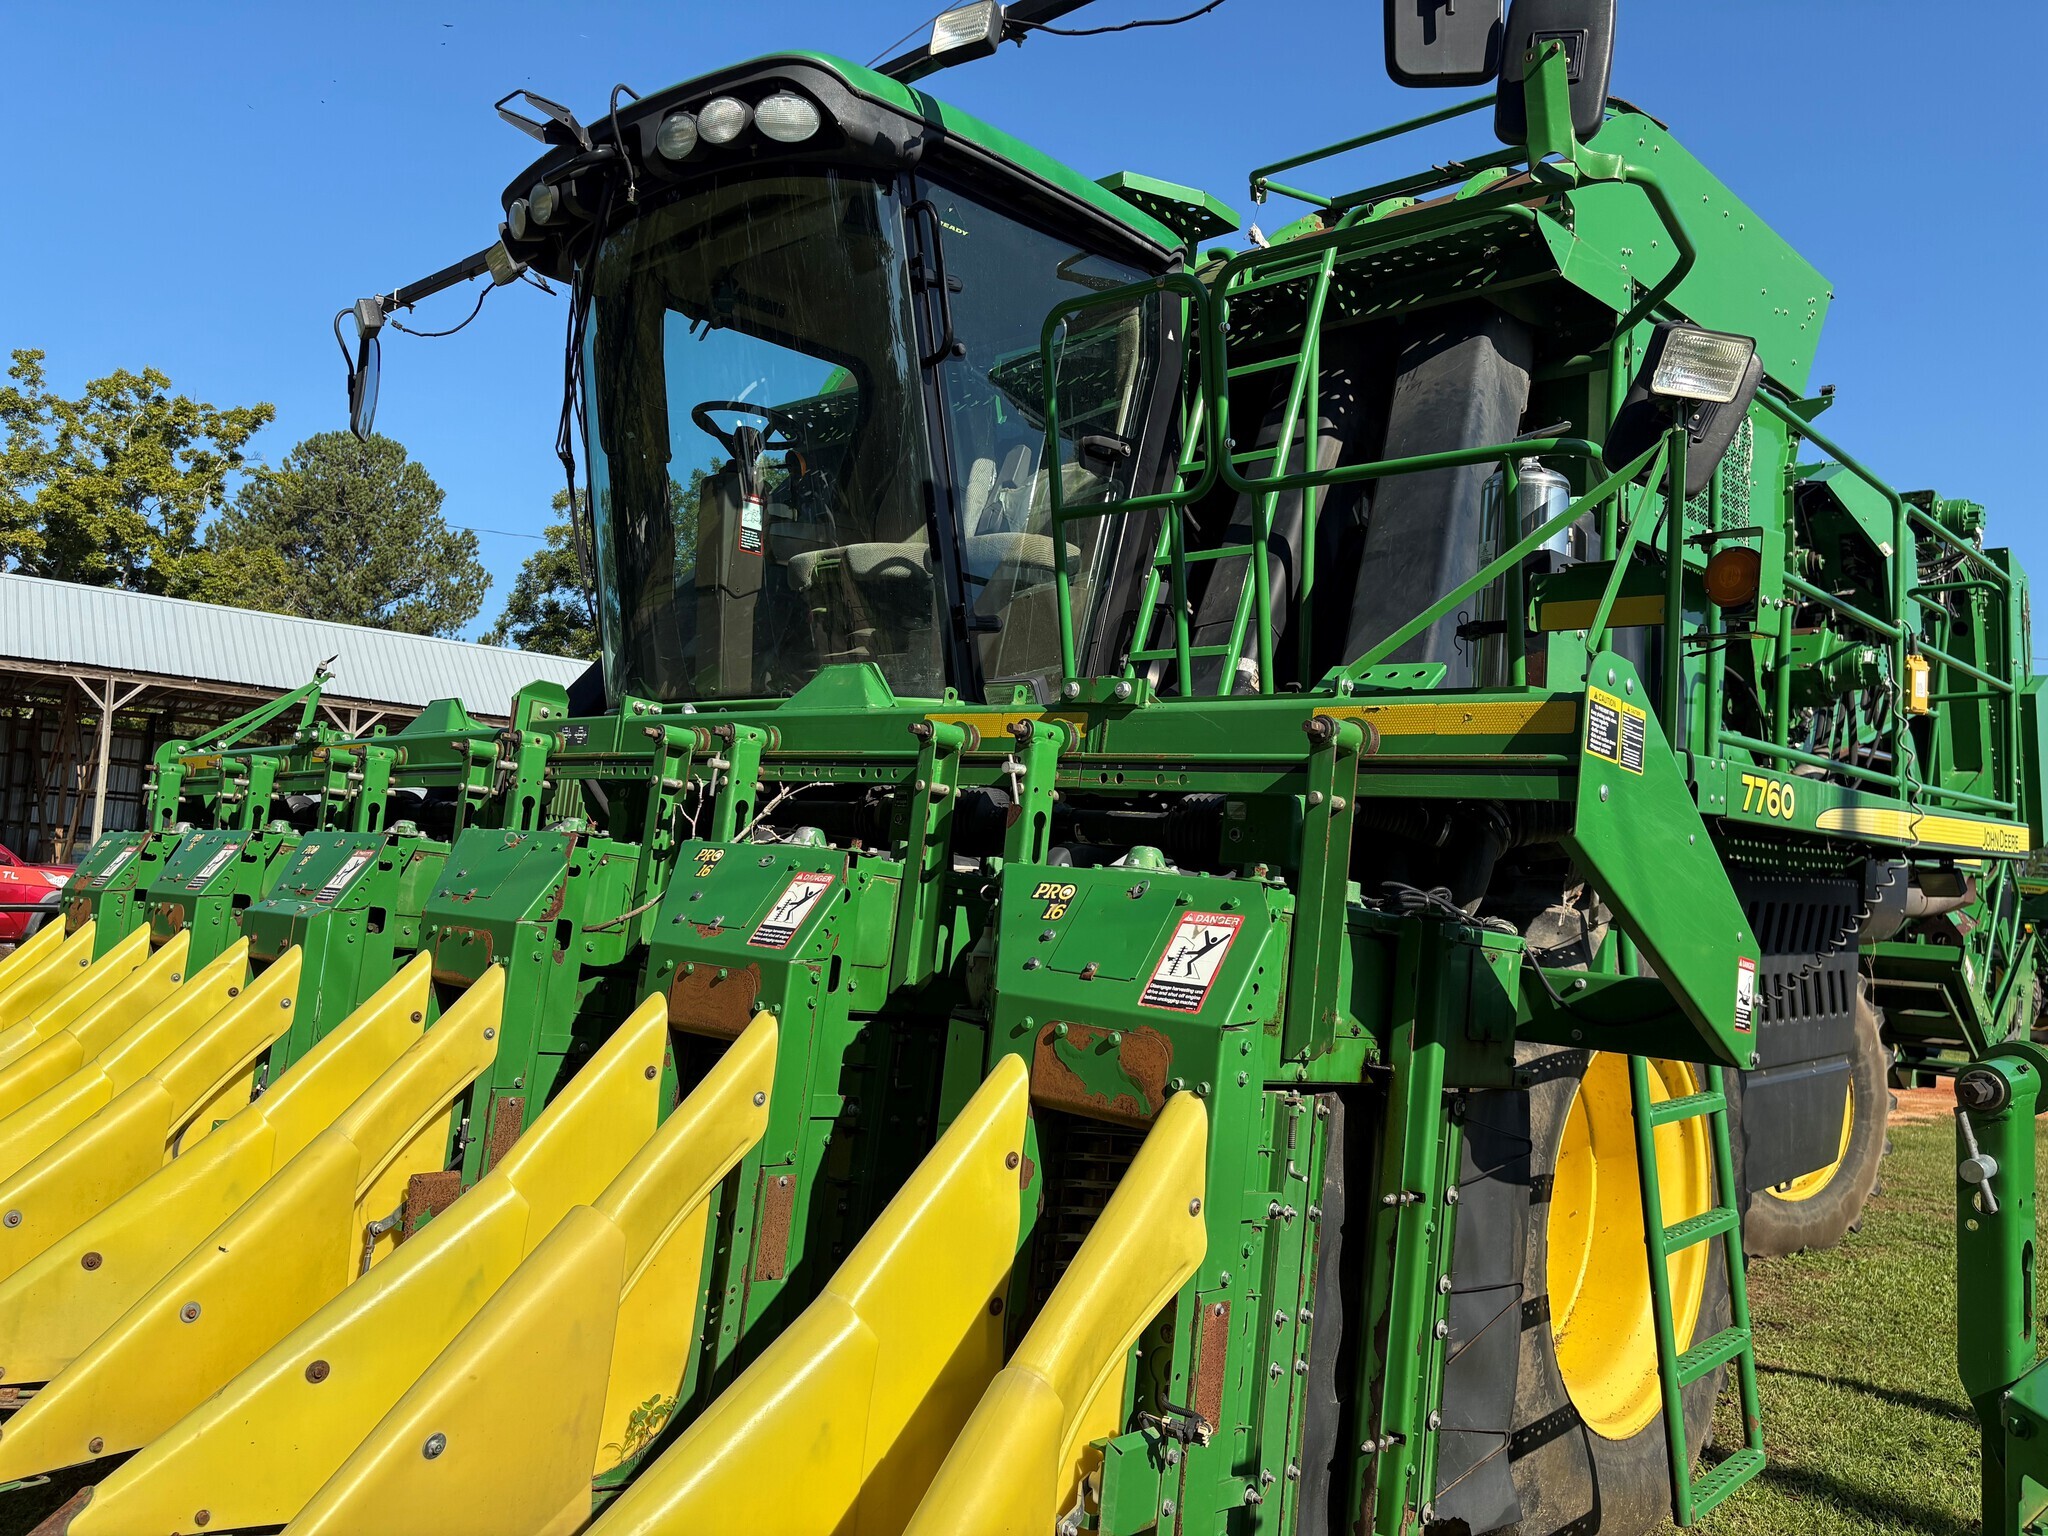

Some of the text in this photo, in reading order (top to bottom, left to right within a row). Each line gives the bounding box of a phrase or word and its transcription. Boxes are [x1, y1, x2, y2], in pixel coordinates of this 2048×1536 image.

[1598, 693, 1616, 708] CAUTION
[1741, 772, 1795, 820] 7760
[693, 848, 725, 862] PRO
[695, 864, 715, 877] 16
[803, 873, 833, 883] DANGER
[1032, 882, 1077, 900] PRO
[1042, 903, 1067, 920] 16
[1195, 914, 1240, 926] DANGER
